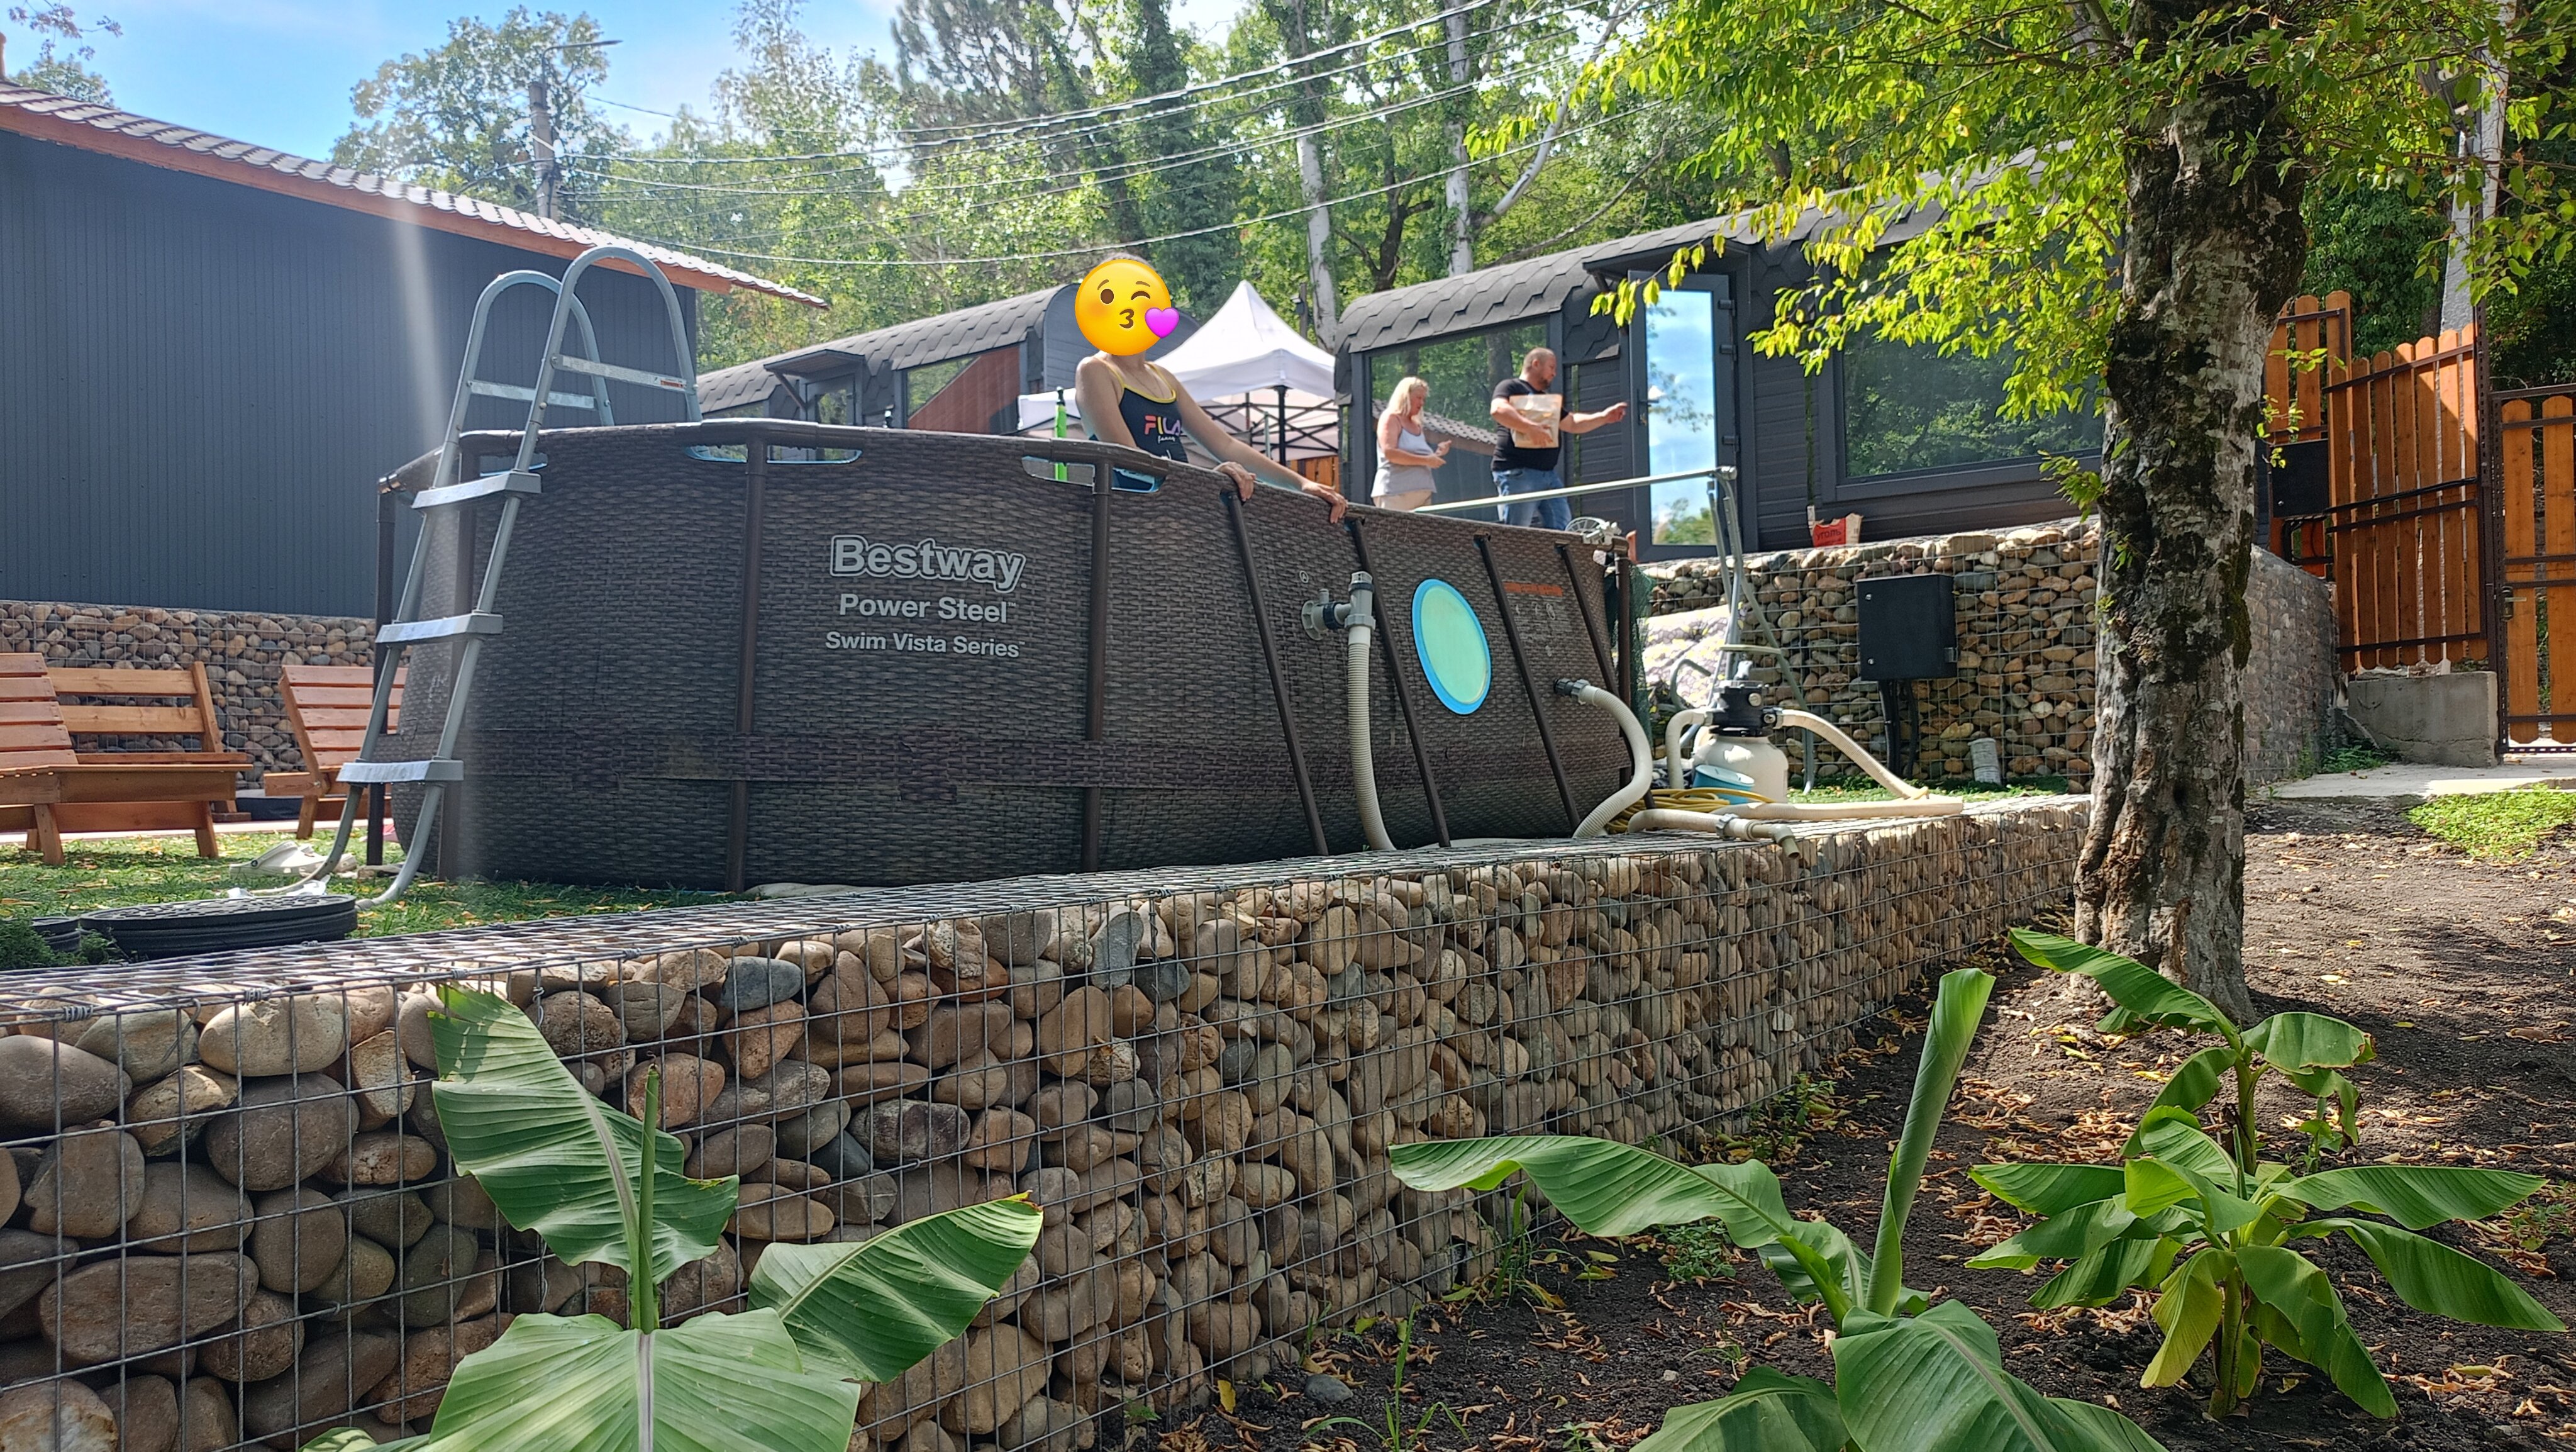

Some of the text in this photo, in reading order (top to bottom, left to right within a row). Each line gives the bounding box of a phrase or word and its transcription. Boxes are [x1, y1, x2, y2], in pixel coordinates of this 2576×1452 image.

[1145, 415, 1180, 435] FILA
[831, 535, 1025, 593] Bestway
[840, 593, 930, 617] Power
[825, 631, 886, 649] Swim
[893, 633, 946, 652] Vista
